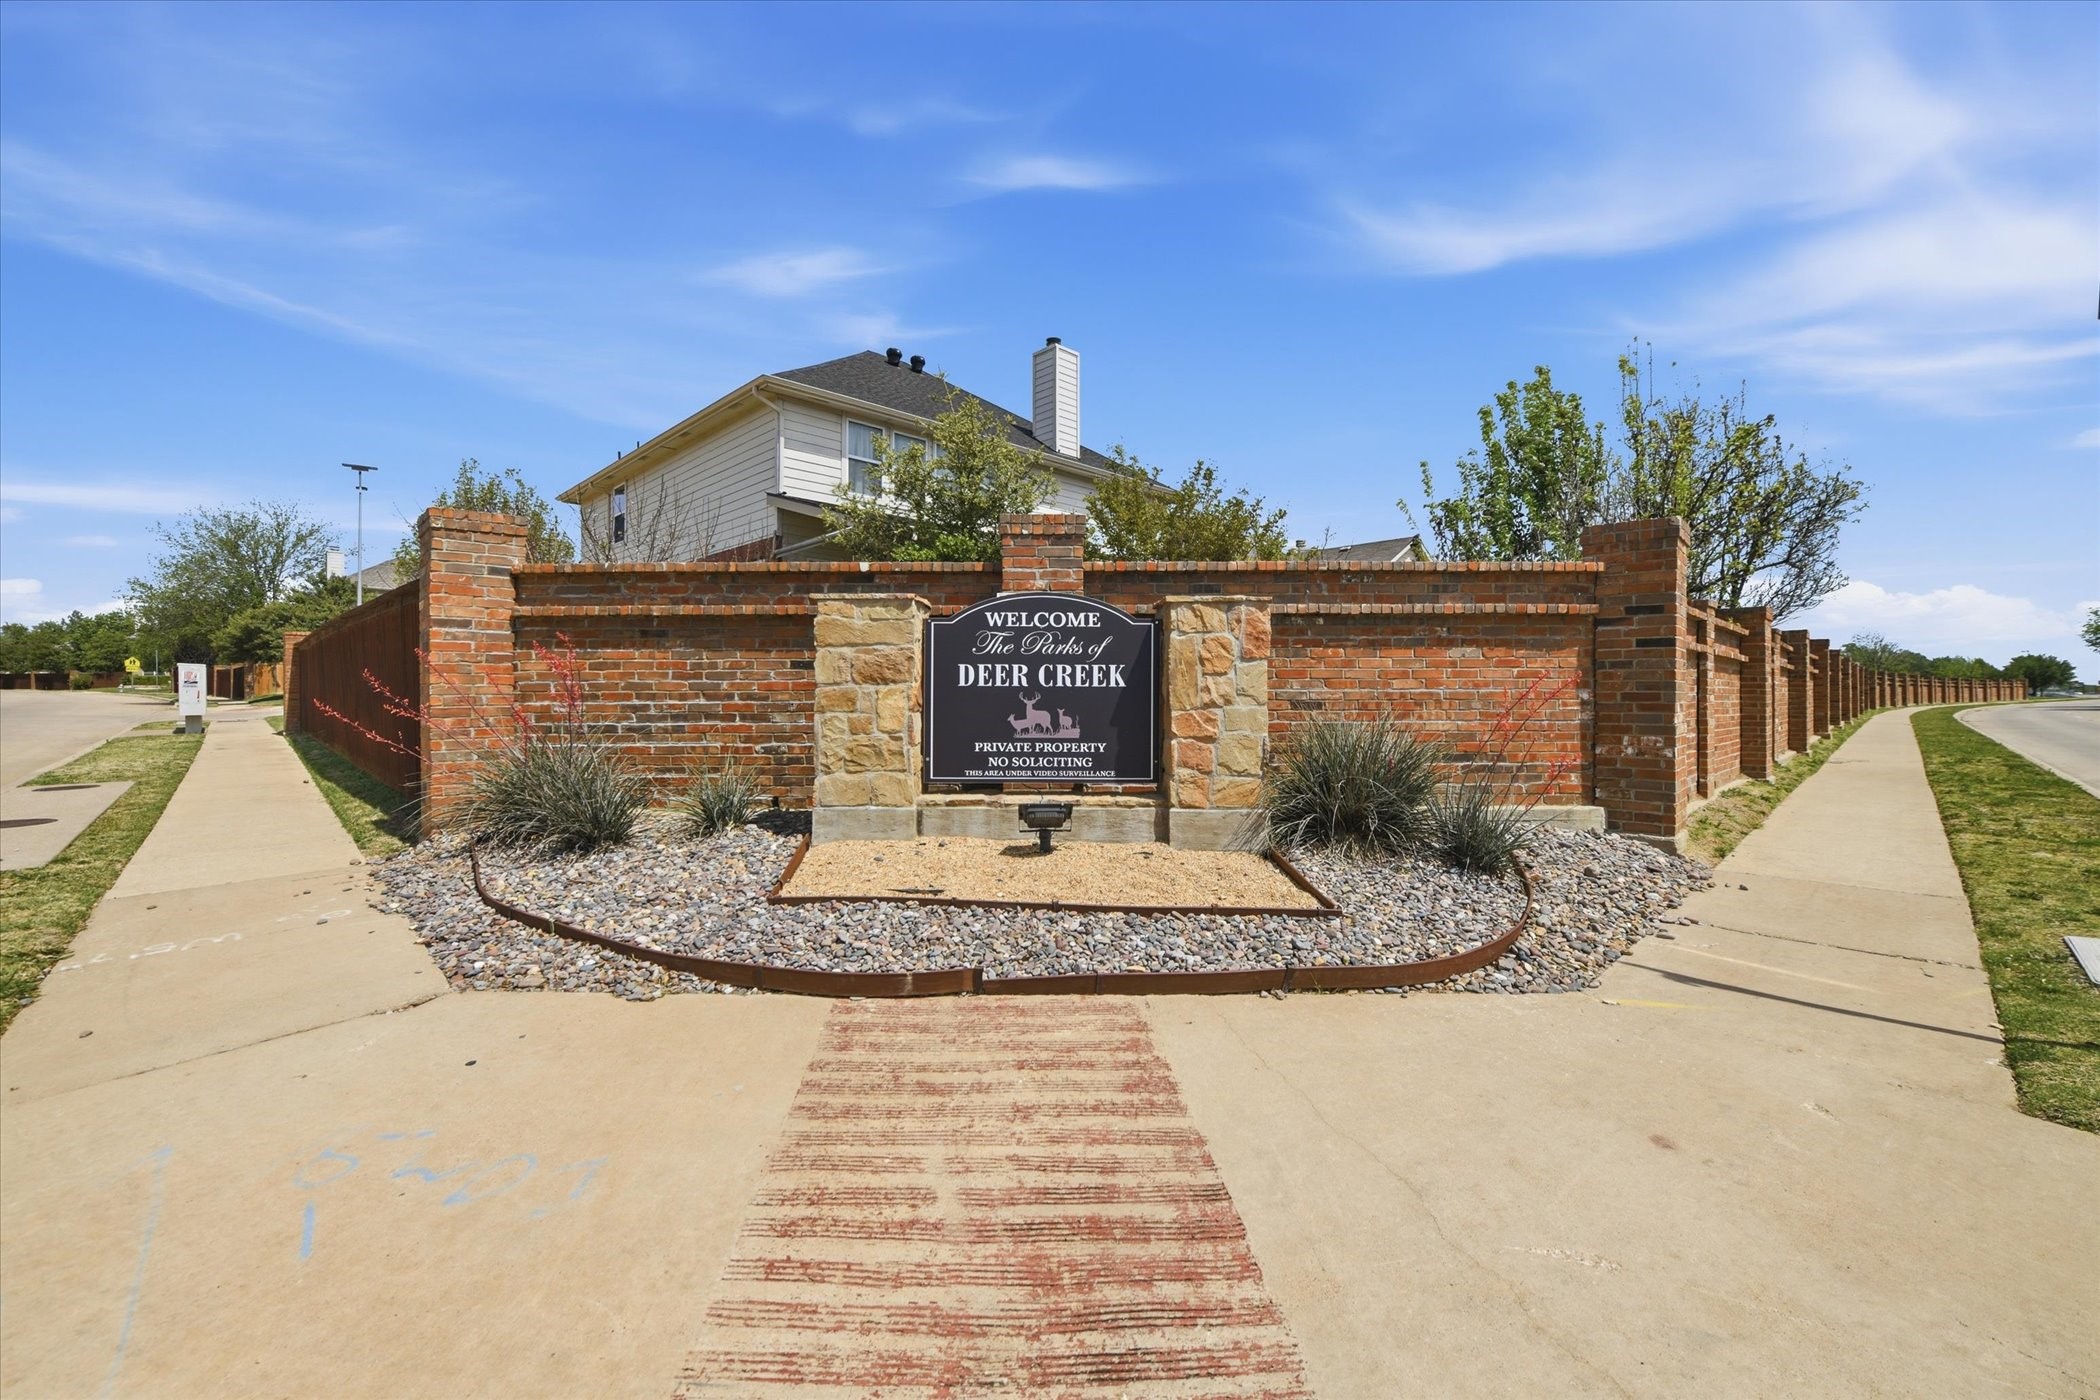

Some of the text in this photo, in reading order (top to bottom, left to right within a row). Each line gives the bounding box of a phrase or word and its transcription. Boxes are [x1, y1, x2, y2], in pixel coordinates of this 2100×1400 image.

[985, 612, 1100, 627] WELCOME
[972, 630, 1112, 663] The Parks of
[958, 664, 1127, 687] DEER CREEK
[975, 743, 1107, 752] PRIVATE PROPERTY
[988, 757, 1092, 767] NO SOLICITING
